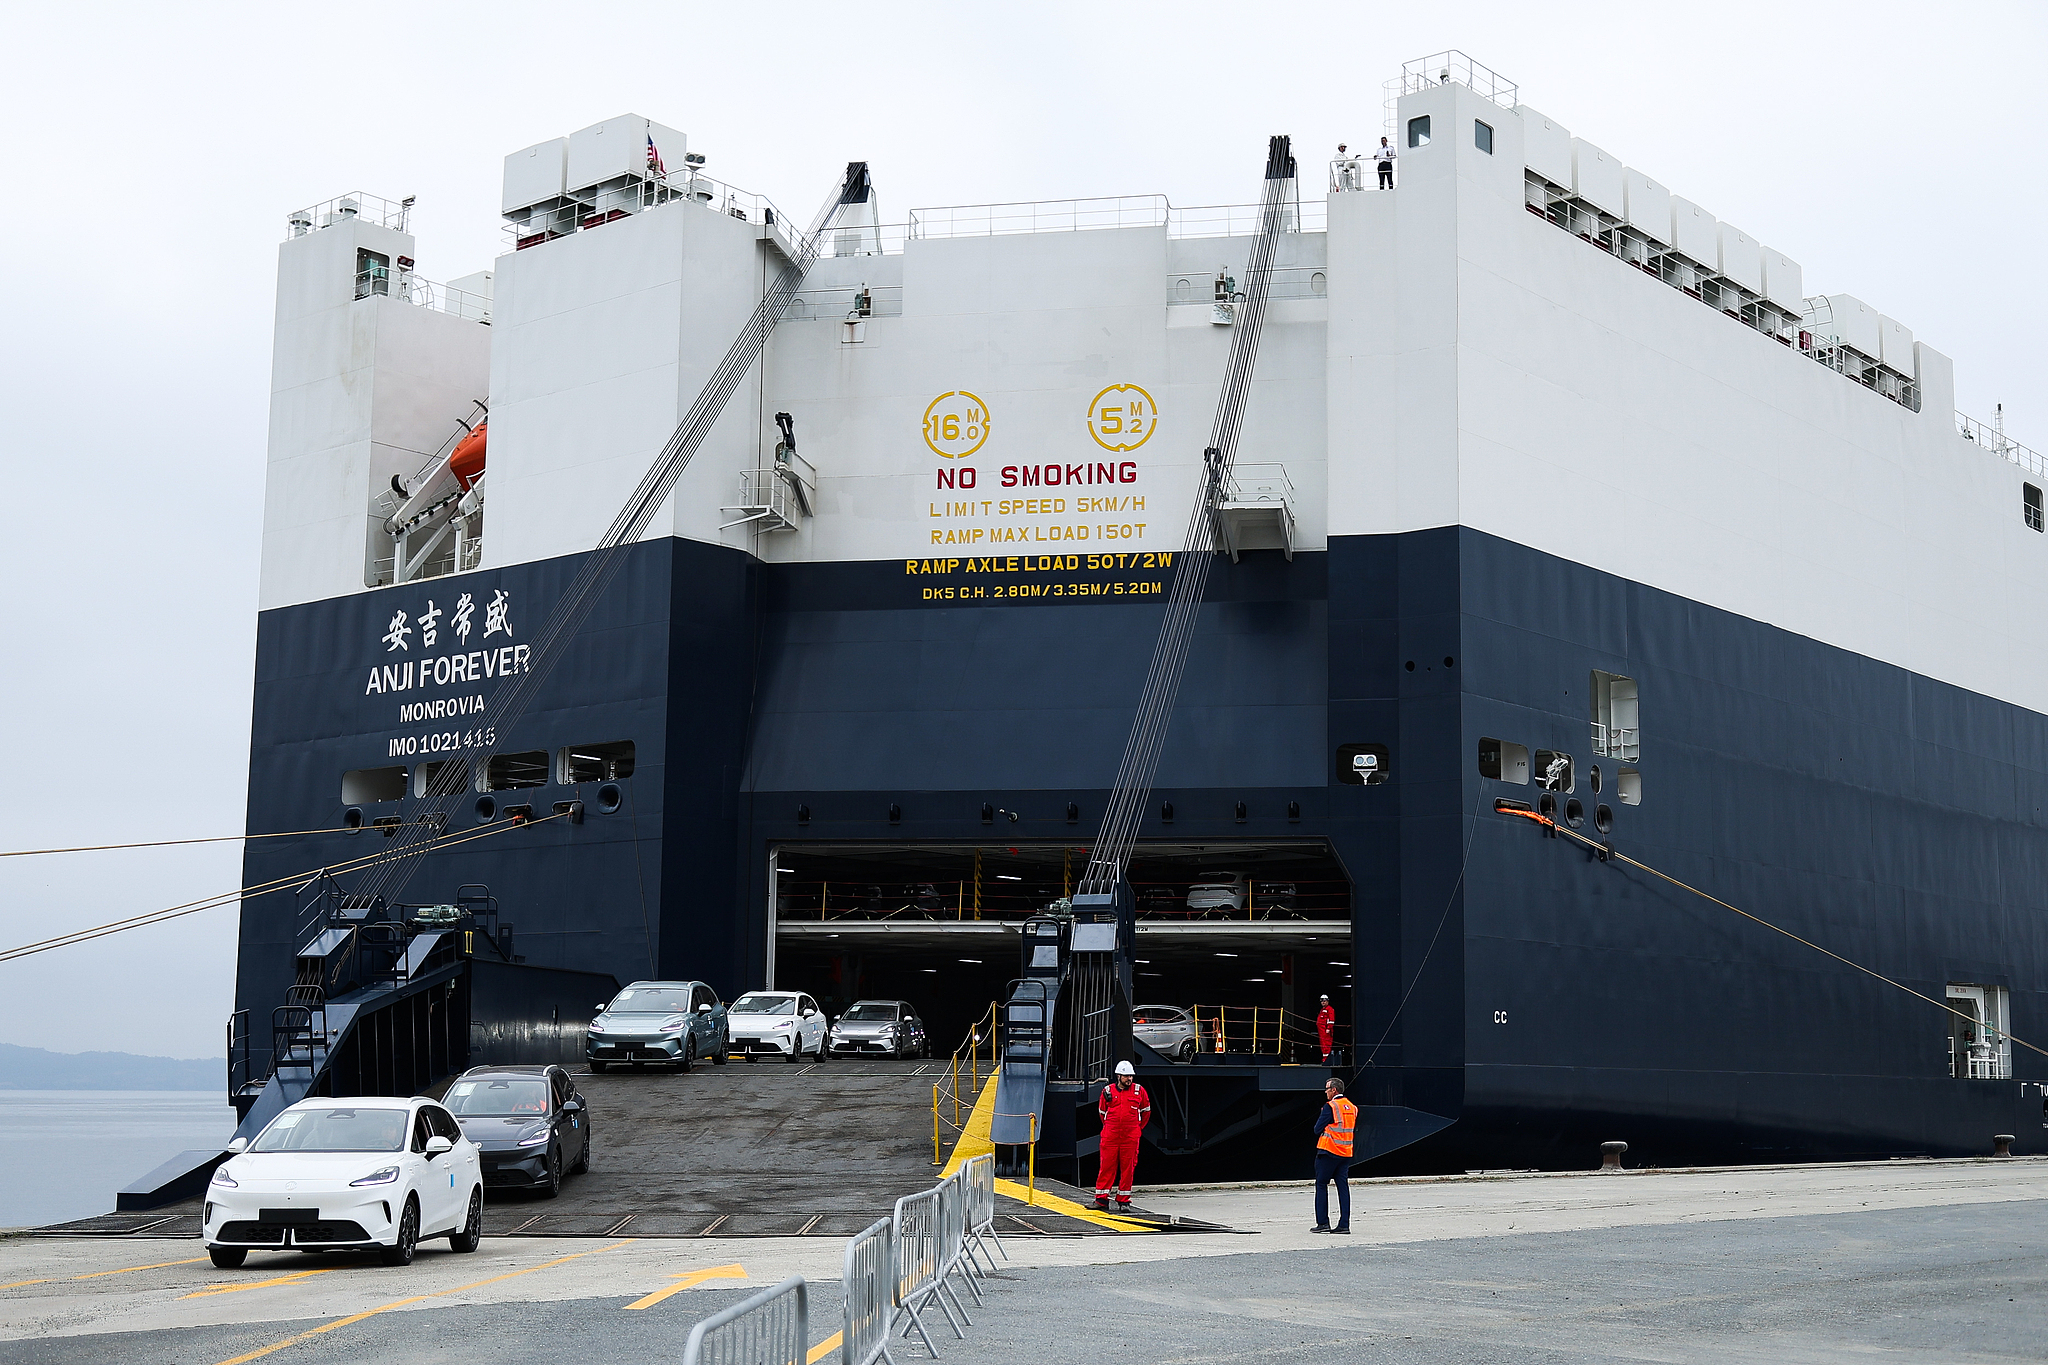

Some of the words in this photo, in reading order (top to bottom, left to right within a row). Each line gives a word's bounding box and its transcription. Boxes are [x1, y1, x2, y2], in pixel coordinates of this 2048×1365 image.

[937, 467, 976, 489] NO
[1001, 461, 1137, 487] SMOKING
[930, 501, 992, 517] LIMIT
[998, 498, 1066, 515] SPEED
[1077, 496, 1145, 513] 5KM/H
[931, 528, 984, 545] RAMP
[990, 526, 1029, 543] MAX
[1035, 525, 1089, 542] LOAD
[1096, 523, 1147, 540] 150T
[906, 558, 960, 575] RAMP
[965, 556, 1019, 573] AXLE
[1025, 554, 1079, 572] LOAD
[1087, 552, 1173, 570] 50T/2W
[923, 587, 955, 600] DK5
[959, 586, 989, 599] C.H.
[381, 588, 513, 653] 安吉常盛
[365, 661, 414, 695] ANJI
[419, 644, 531, 688] FOREVER
[399, 694, 485, 723] MONROVIA
[388, 737, 417, 757] IMO
[1494, 1010, 1507, 1024] CC
